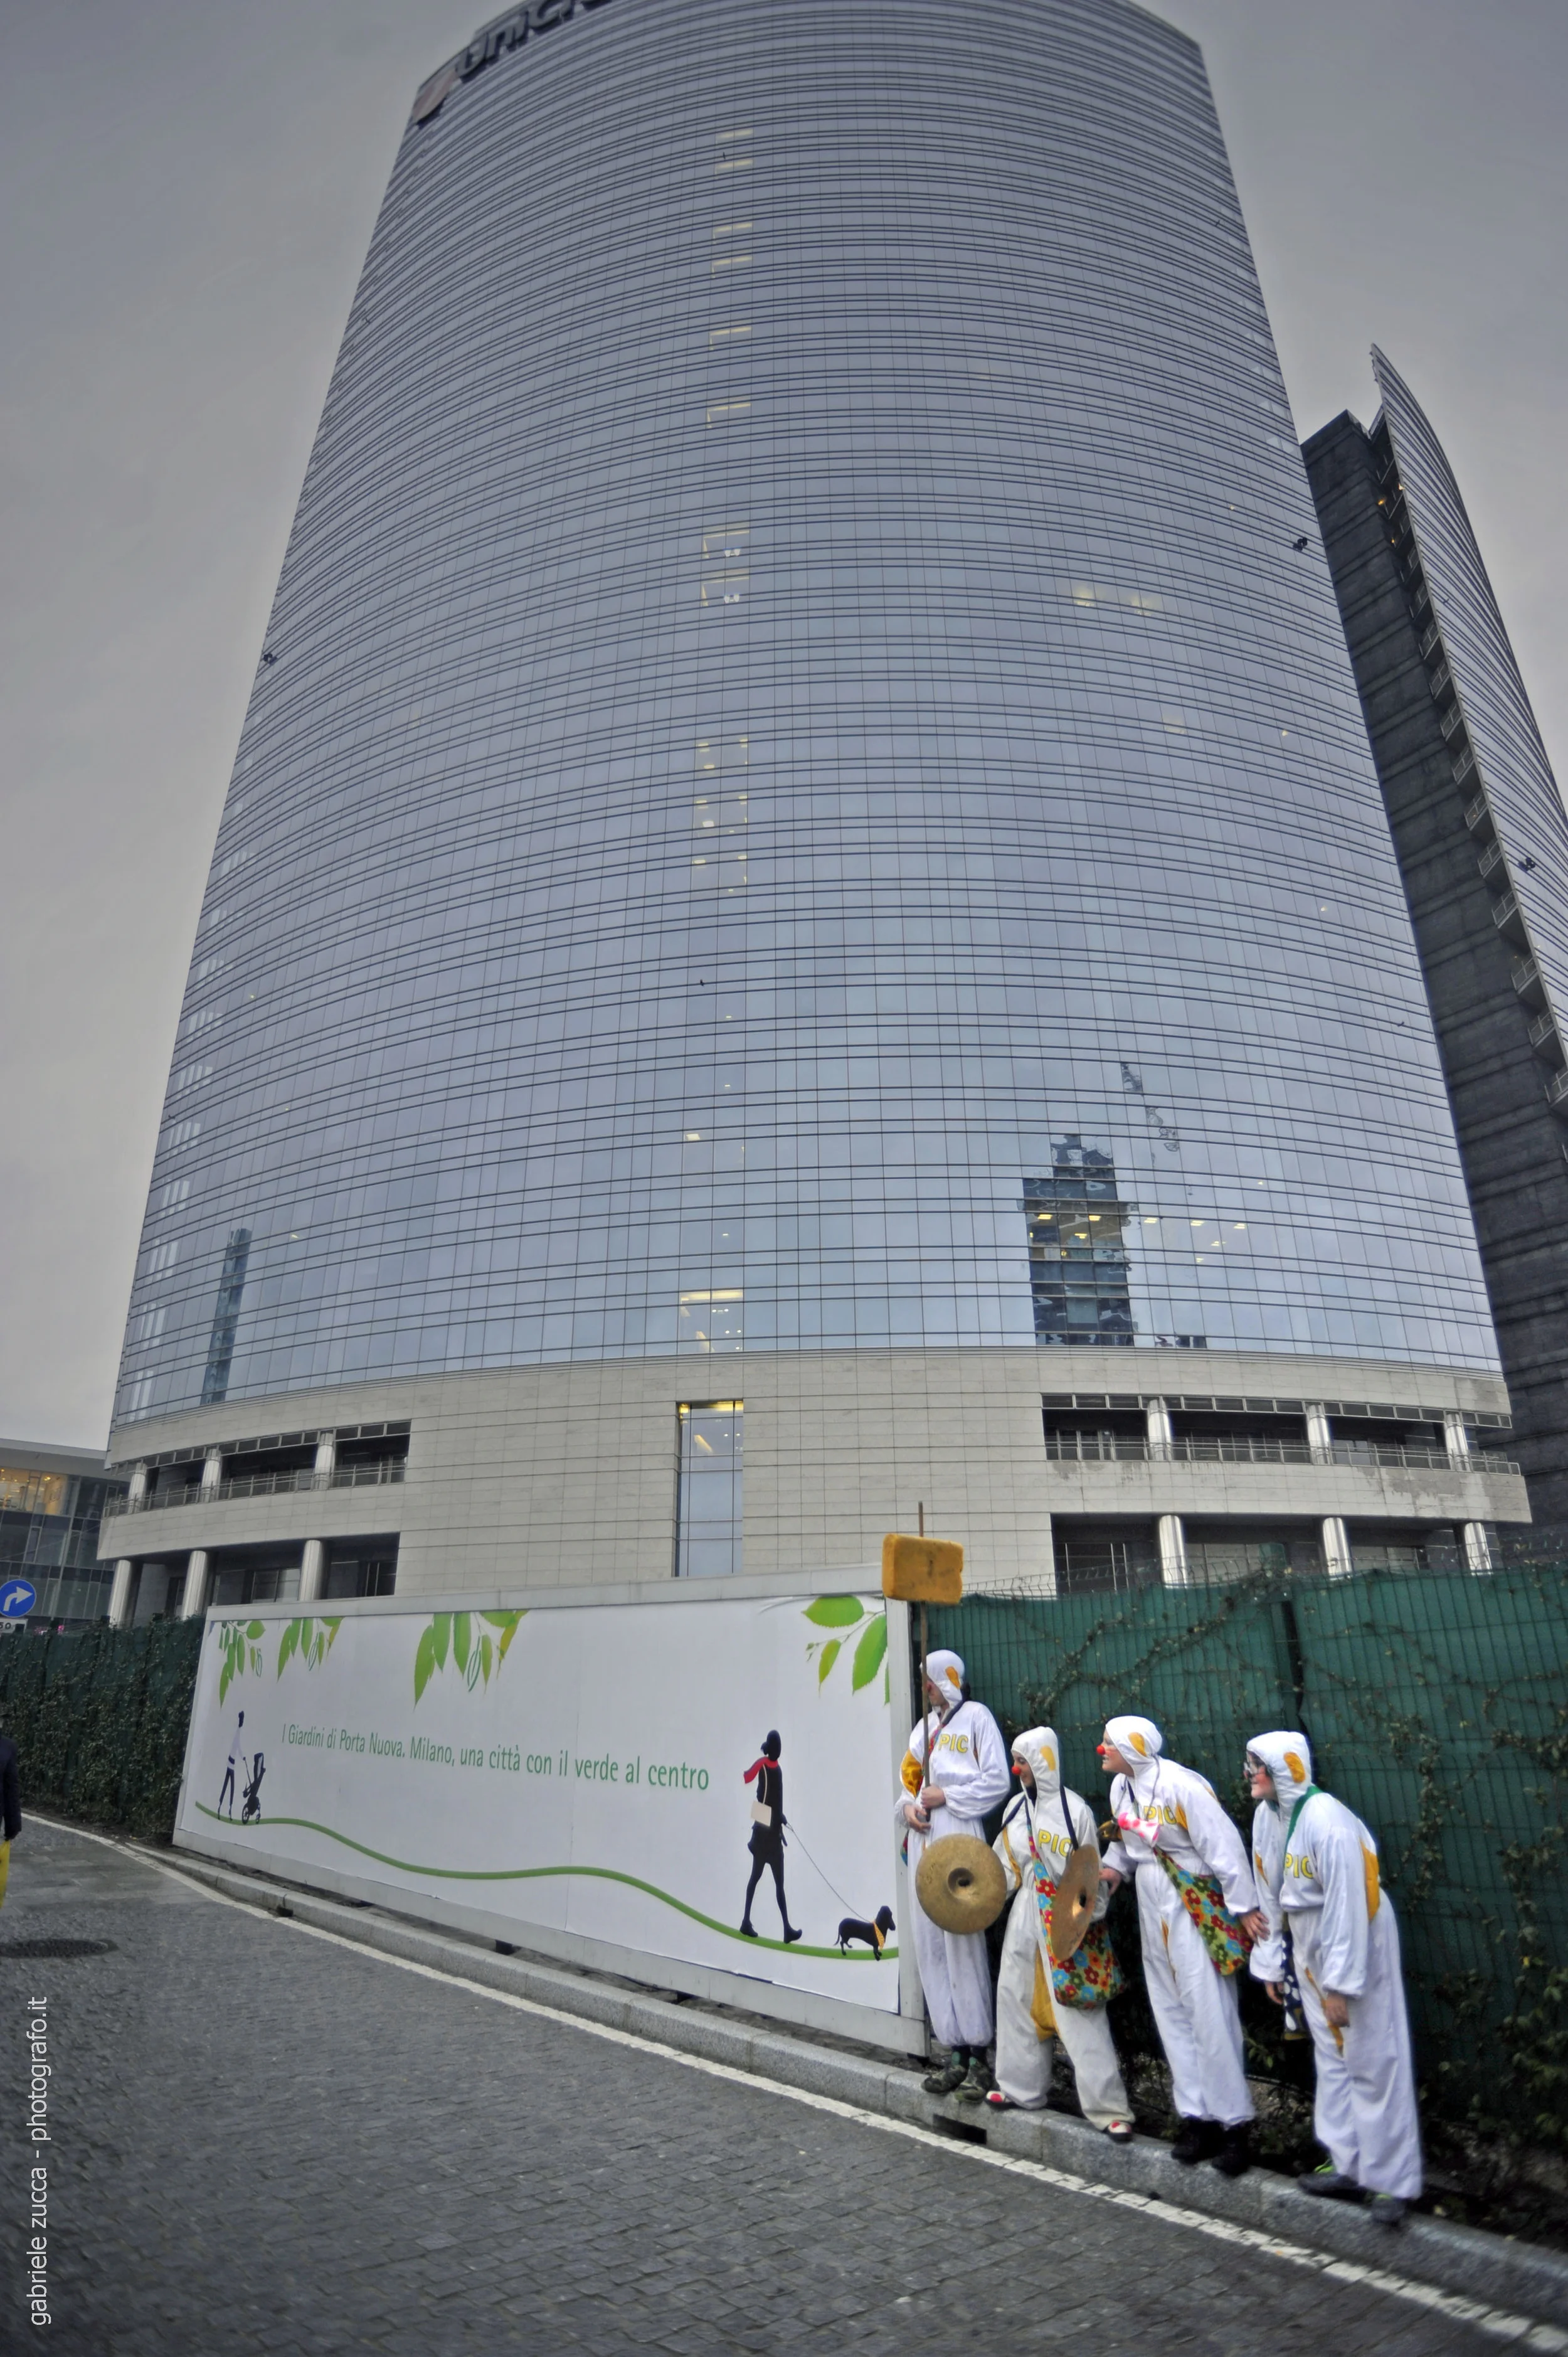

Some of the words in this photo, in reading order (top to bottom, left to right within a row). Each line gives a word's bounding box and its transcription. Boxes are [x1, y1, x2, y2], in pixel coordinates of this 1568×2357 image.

[938, 1733, 969, 1753] PIC
[282, 1723, 286, 1743] I
[289, 1724, 324, 1747] Giardini
[327, 1728, 337, 1749] di
[339, 1729, 365, 1753] Porta
[410, 1737, 455, 1767] Milano,
[460, 1748, 484, 1767] una
[489, 1744, 521, 1772] città
[527, 1754, 551, 1775] con
[559, 1750, 568, 1777] il
[575, 1753, 619, 1782] verde
[625, 1756, 640, 1784] al
[648, 1761, 709, 1791] centro
[1284, 1853, 1313, 1879] PIC
